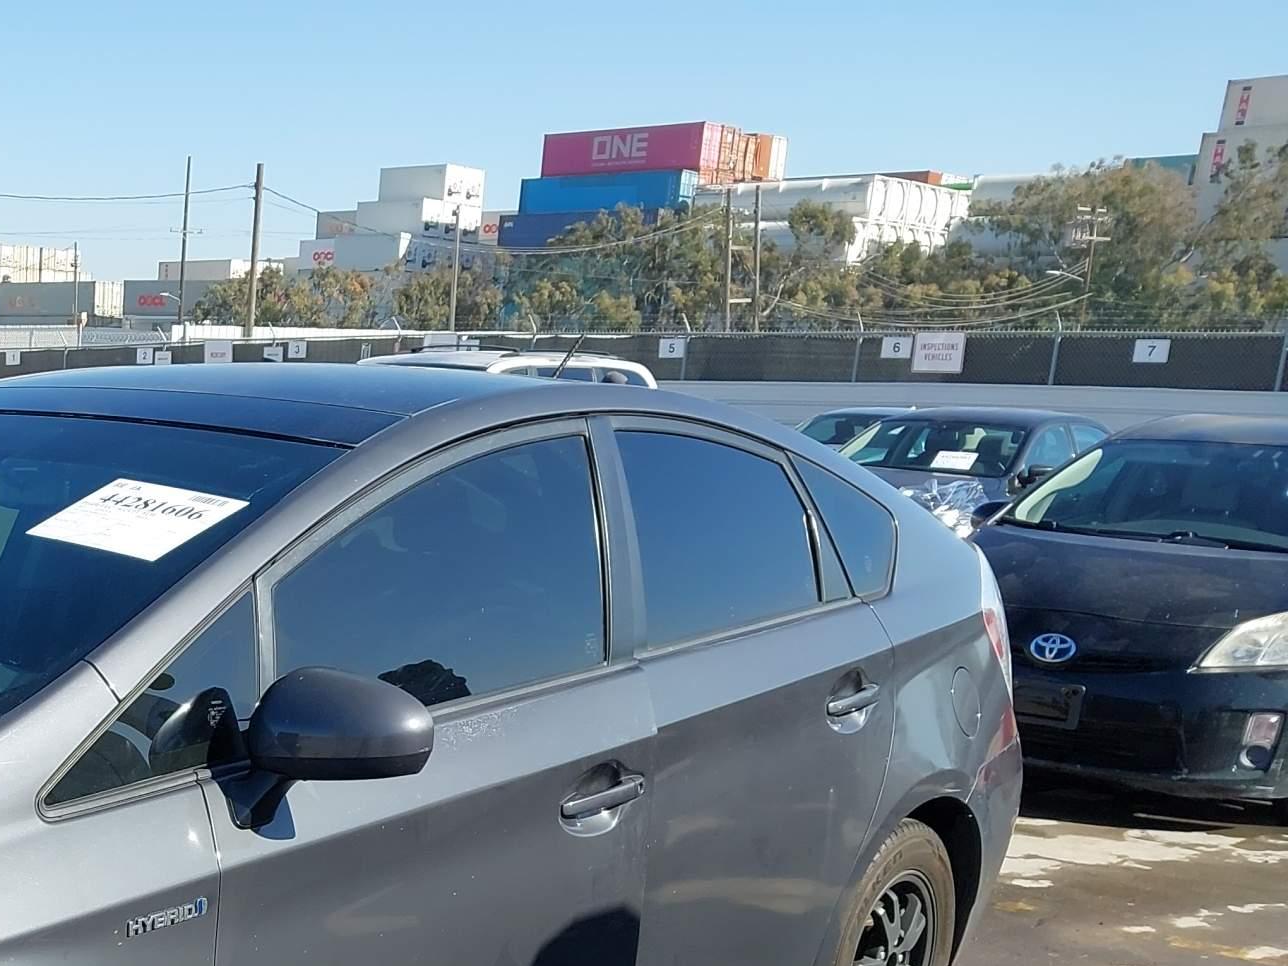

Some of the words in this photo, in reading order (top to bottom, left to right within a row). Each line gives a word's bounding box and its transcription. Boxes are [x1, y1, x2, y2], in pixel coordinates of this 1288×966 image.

[592, 133, 649, 160] ONE
[668, 343, 676, 353] 5
[892, 342, 901, 353] 6
[920, 343, 959, 351] INSPECTIONS
[1147, 345, 1157, 357] 7
[924, 352, 953, 361] VEHICLES
[99, 493, 208, 520] 44281606
[126, 903, 196, 938] HYBRID
